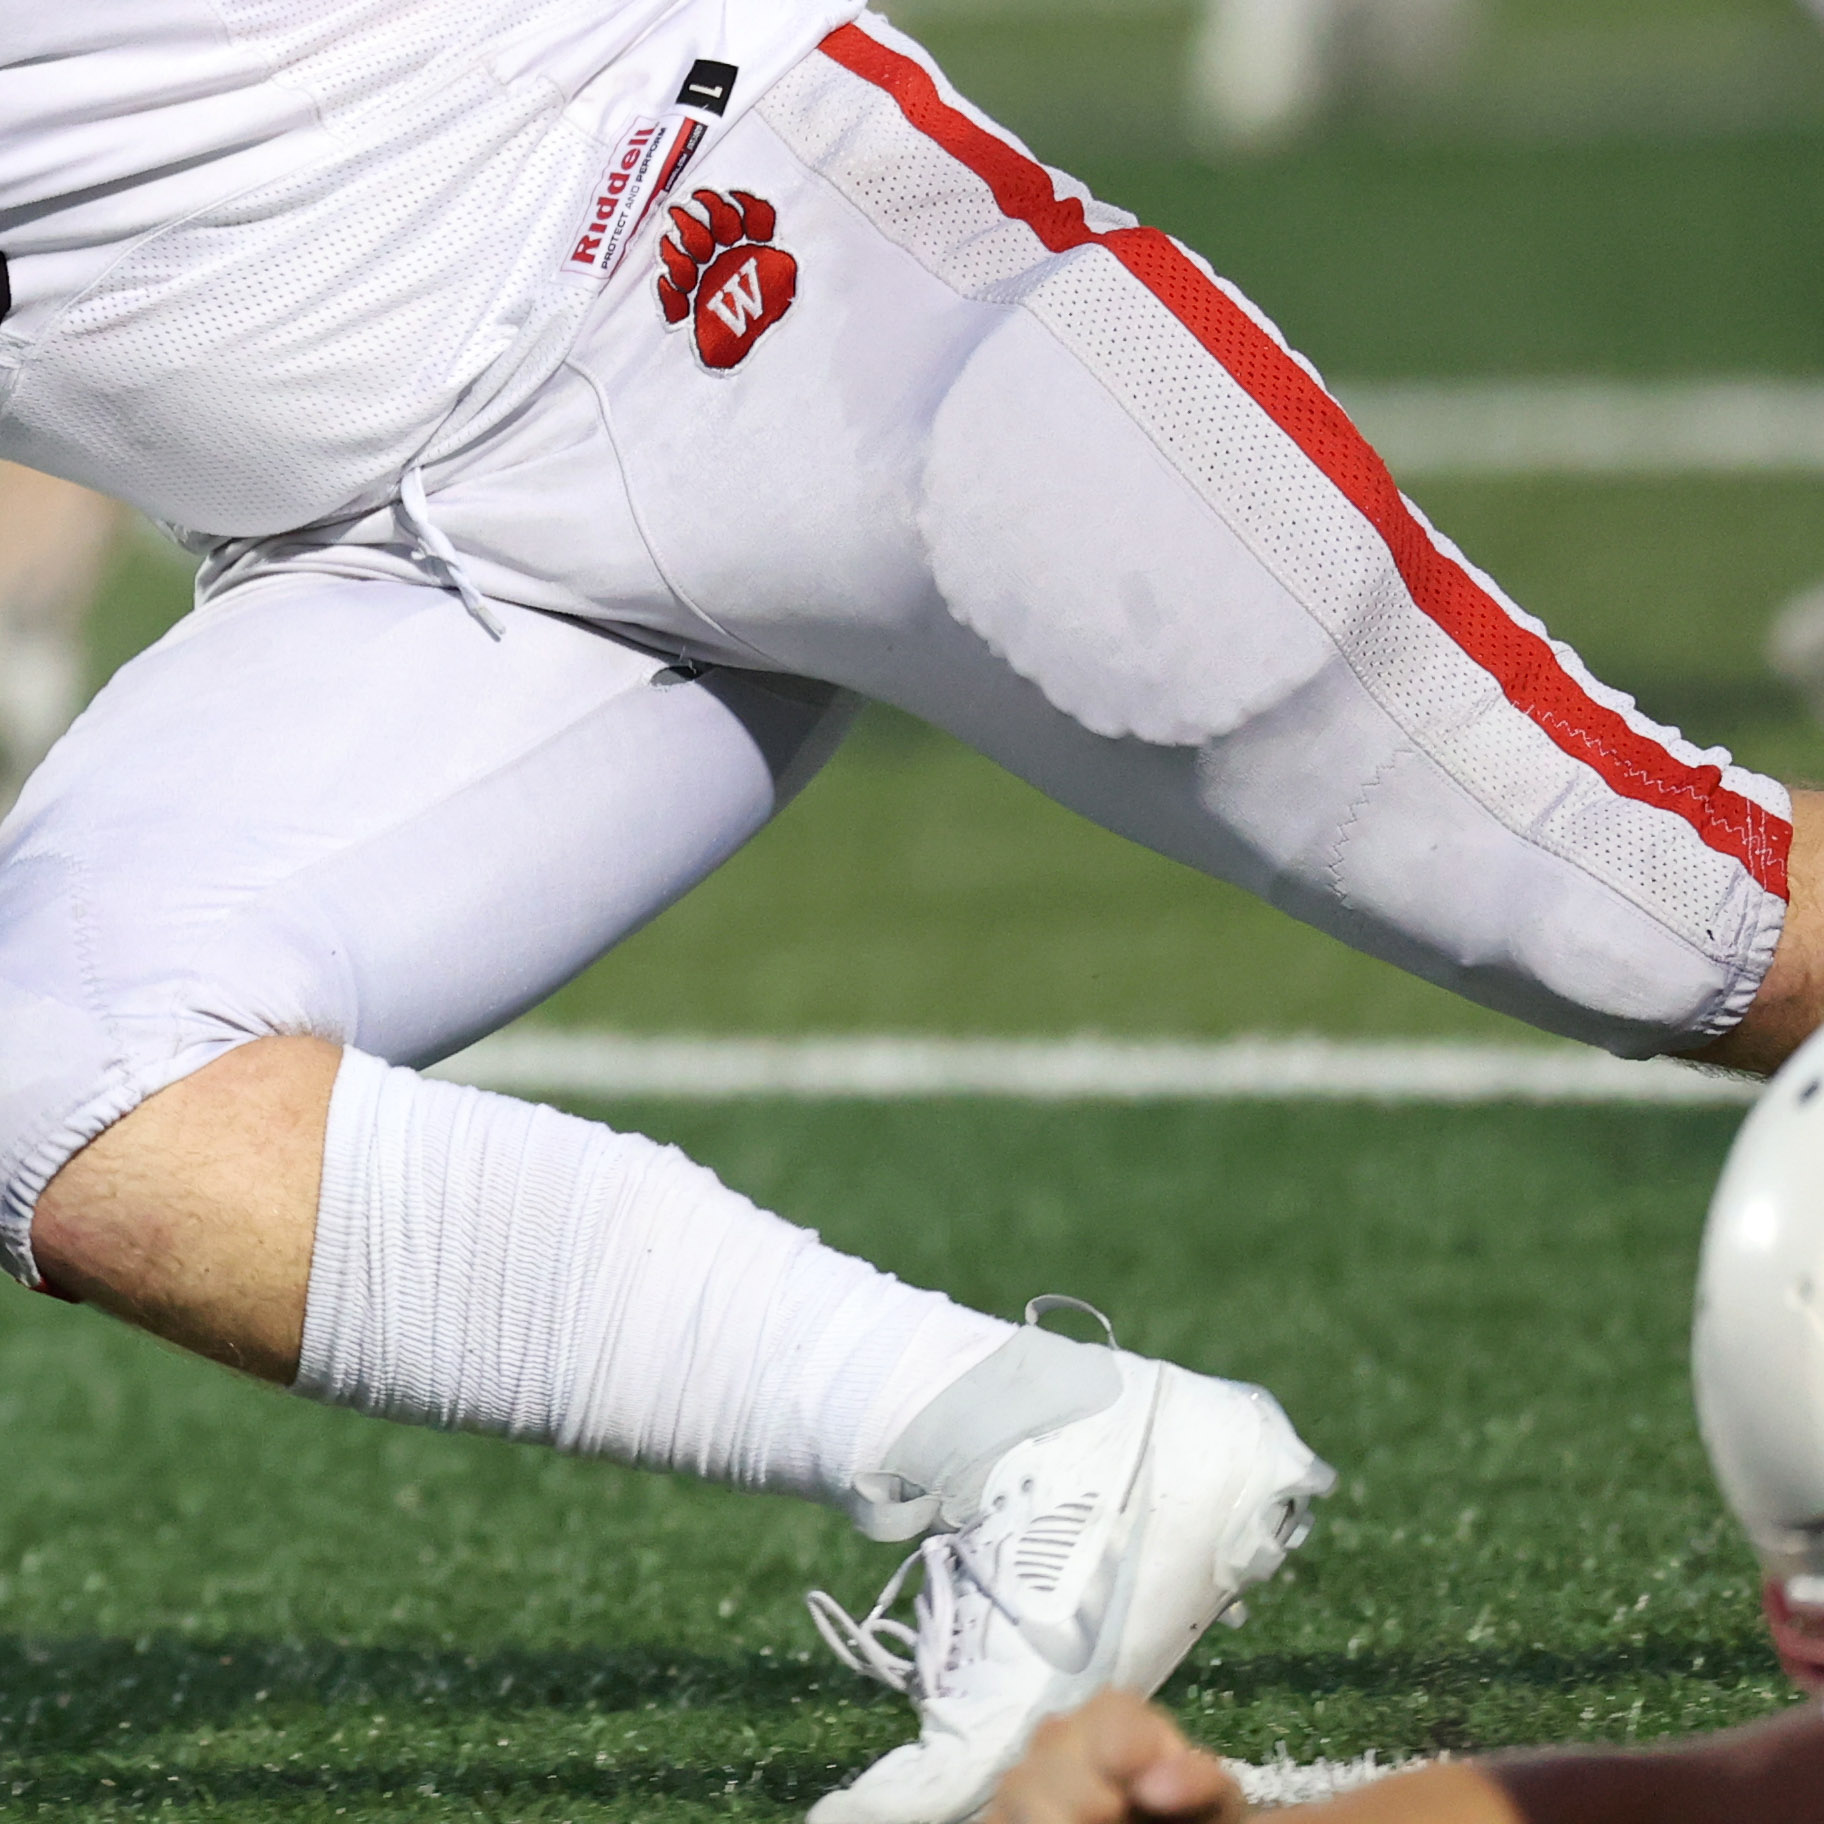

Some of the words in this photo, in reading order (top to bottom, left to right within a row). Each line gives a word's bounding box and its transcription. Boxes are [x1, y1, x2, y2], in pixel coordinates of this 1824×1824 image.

[569, 126, 654, 264] Riddell
[600, 210, 632, 270] PROTECT
[624, 185, 640, 210] AND
[634, 126, 666, 183] PERFORM
[705, 257, 767, 339] W
